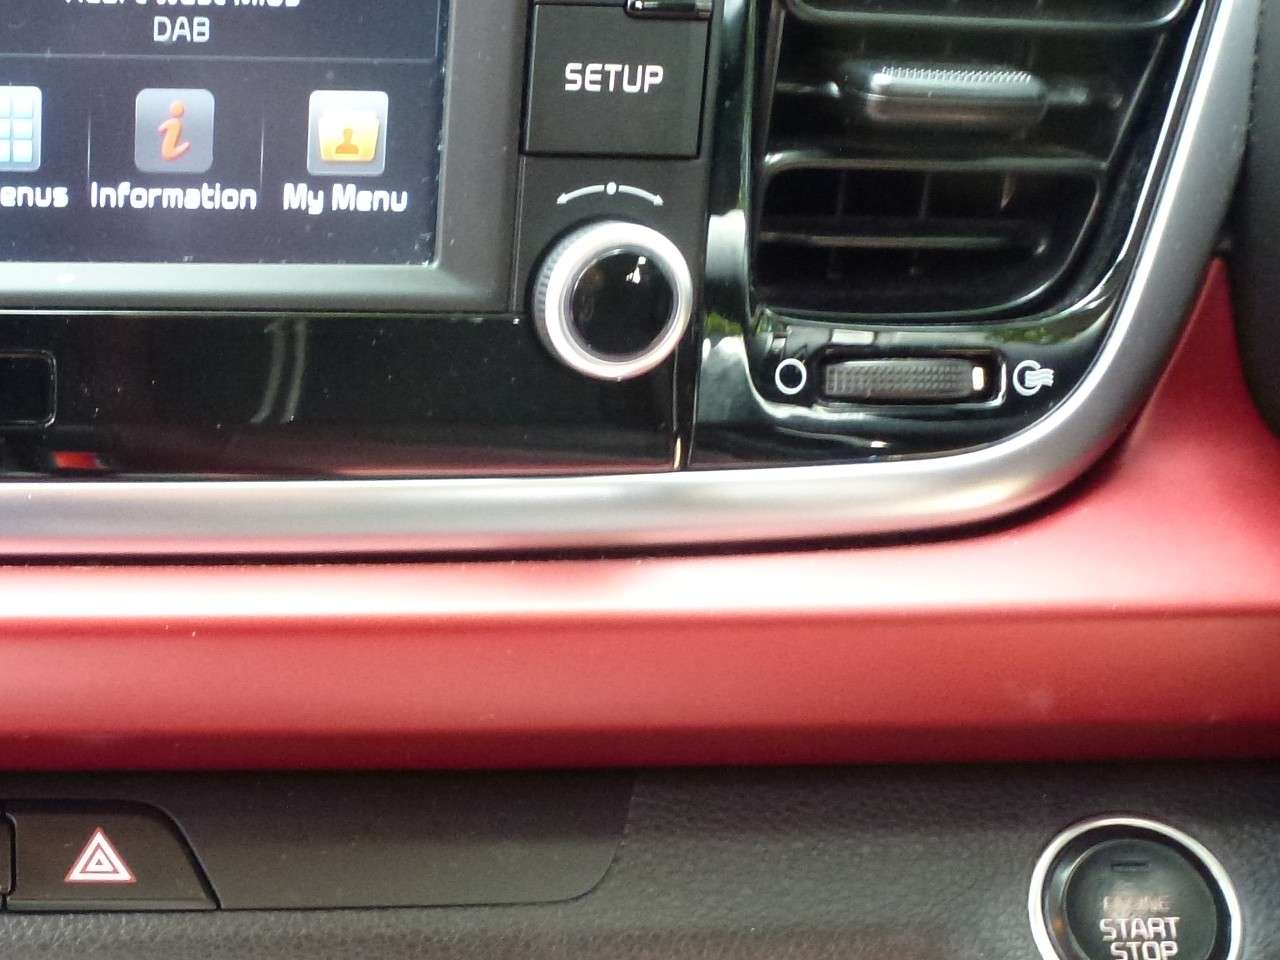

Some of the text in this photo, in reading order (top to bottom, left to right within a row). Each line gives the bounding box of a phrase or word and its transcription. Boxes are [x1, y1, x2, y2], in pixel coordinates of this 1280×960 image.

[153, 15, 210, 43] DAB
[564, 62, 664, 94] SETUP
[90, 181, 258, 210] Information
[282, 182, 408, 215] My Menu
[1099, 916, 1181, 942] START
